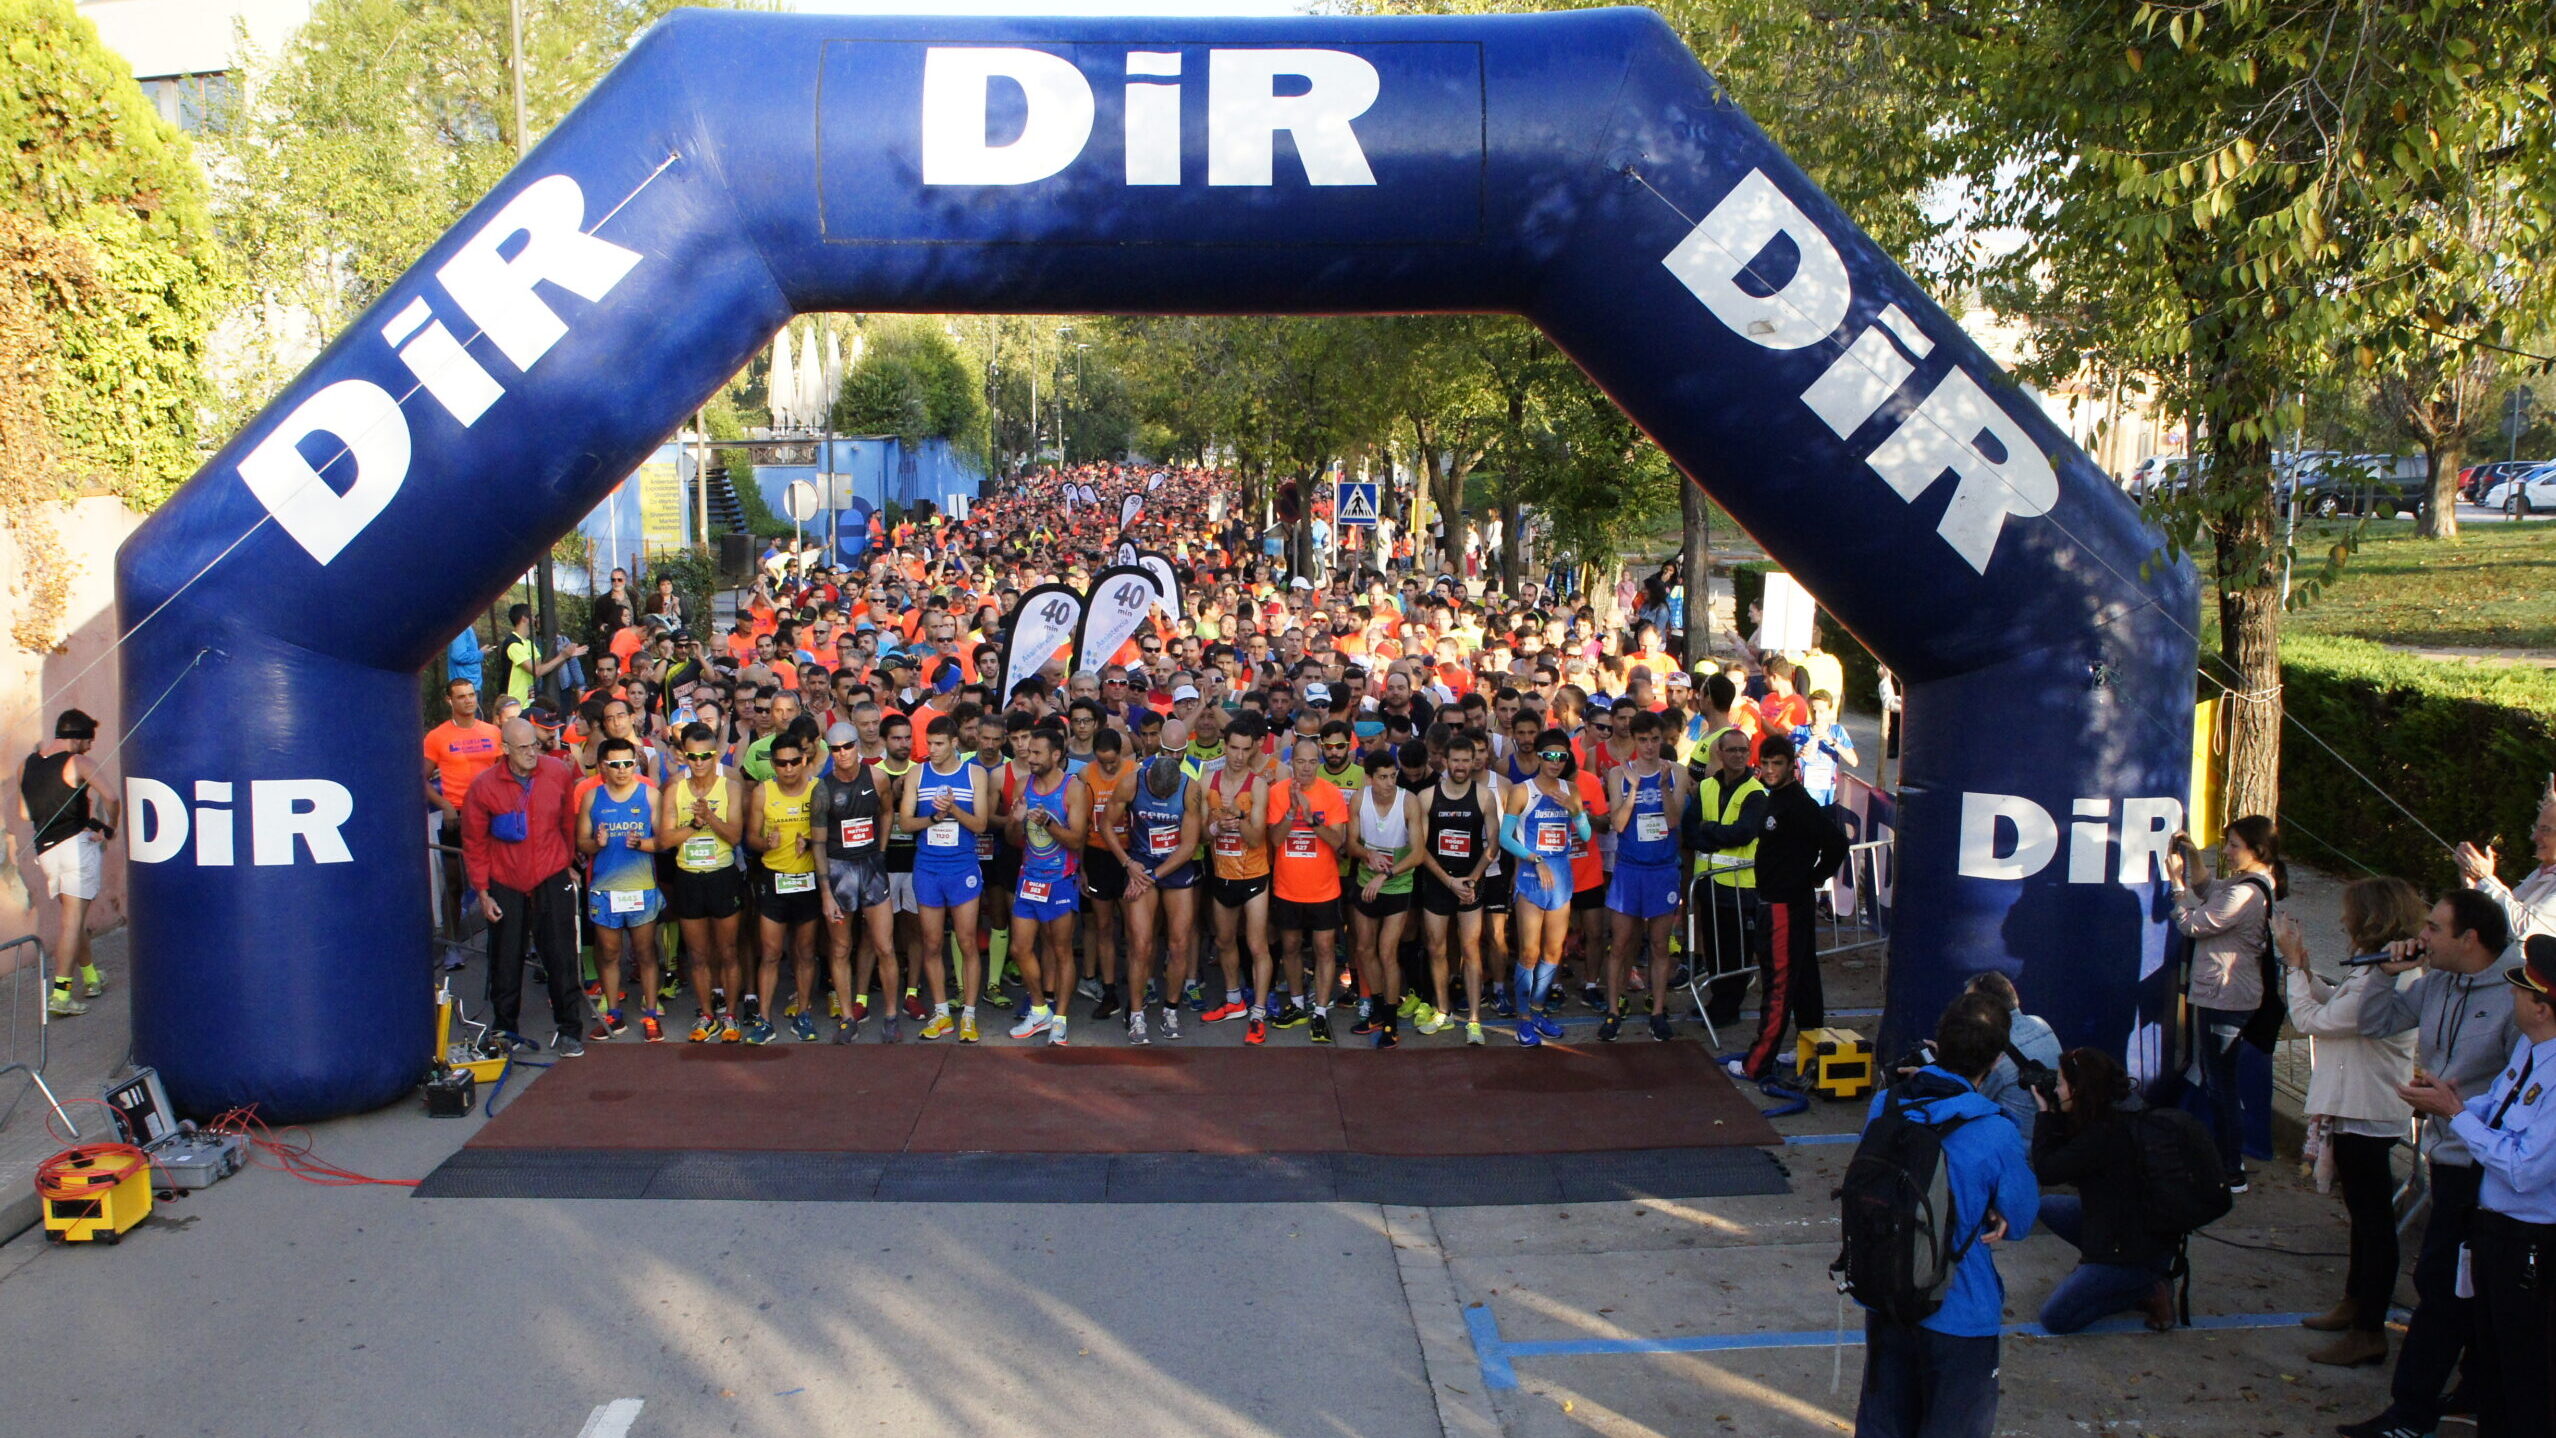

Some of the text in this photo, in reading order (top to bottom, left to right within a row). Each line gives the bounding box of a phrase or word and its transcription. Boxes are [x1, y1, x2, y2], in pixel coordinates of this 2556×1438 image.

[922, 47, 1380, 186] DiR
[236, 174, 644, 566] DiR
[1662, 167, 2060, 576] DiR
[1113, 582, 1145, 609] 40
[1040, 599, 1070, 625] 40
[1117, 608, 1133, 617] min
[1043, 624, 1059, 633] min
[126, 777, 354, 867] DiR
[598, 821, 645, 831] CUADOR
